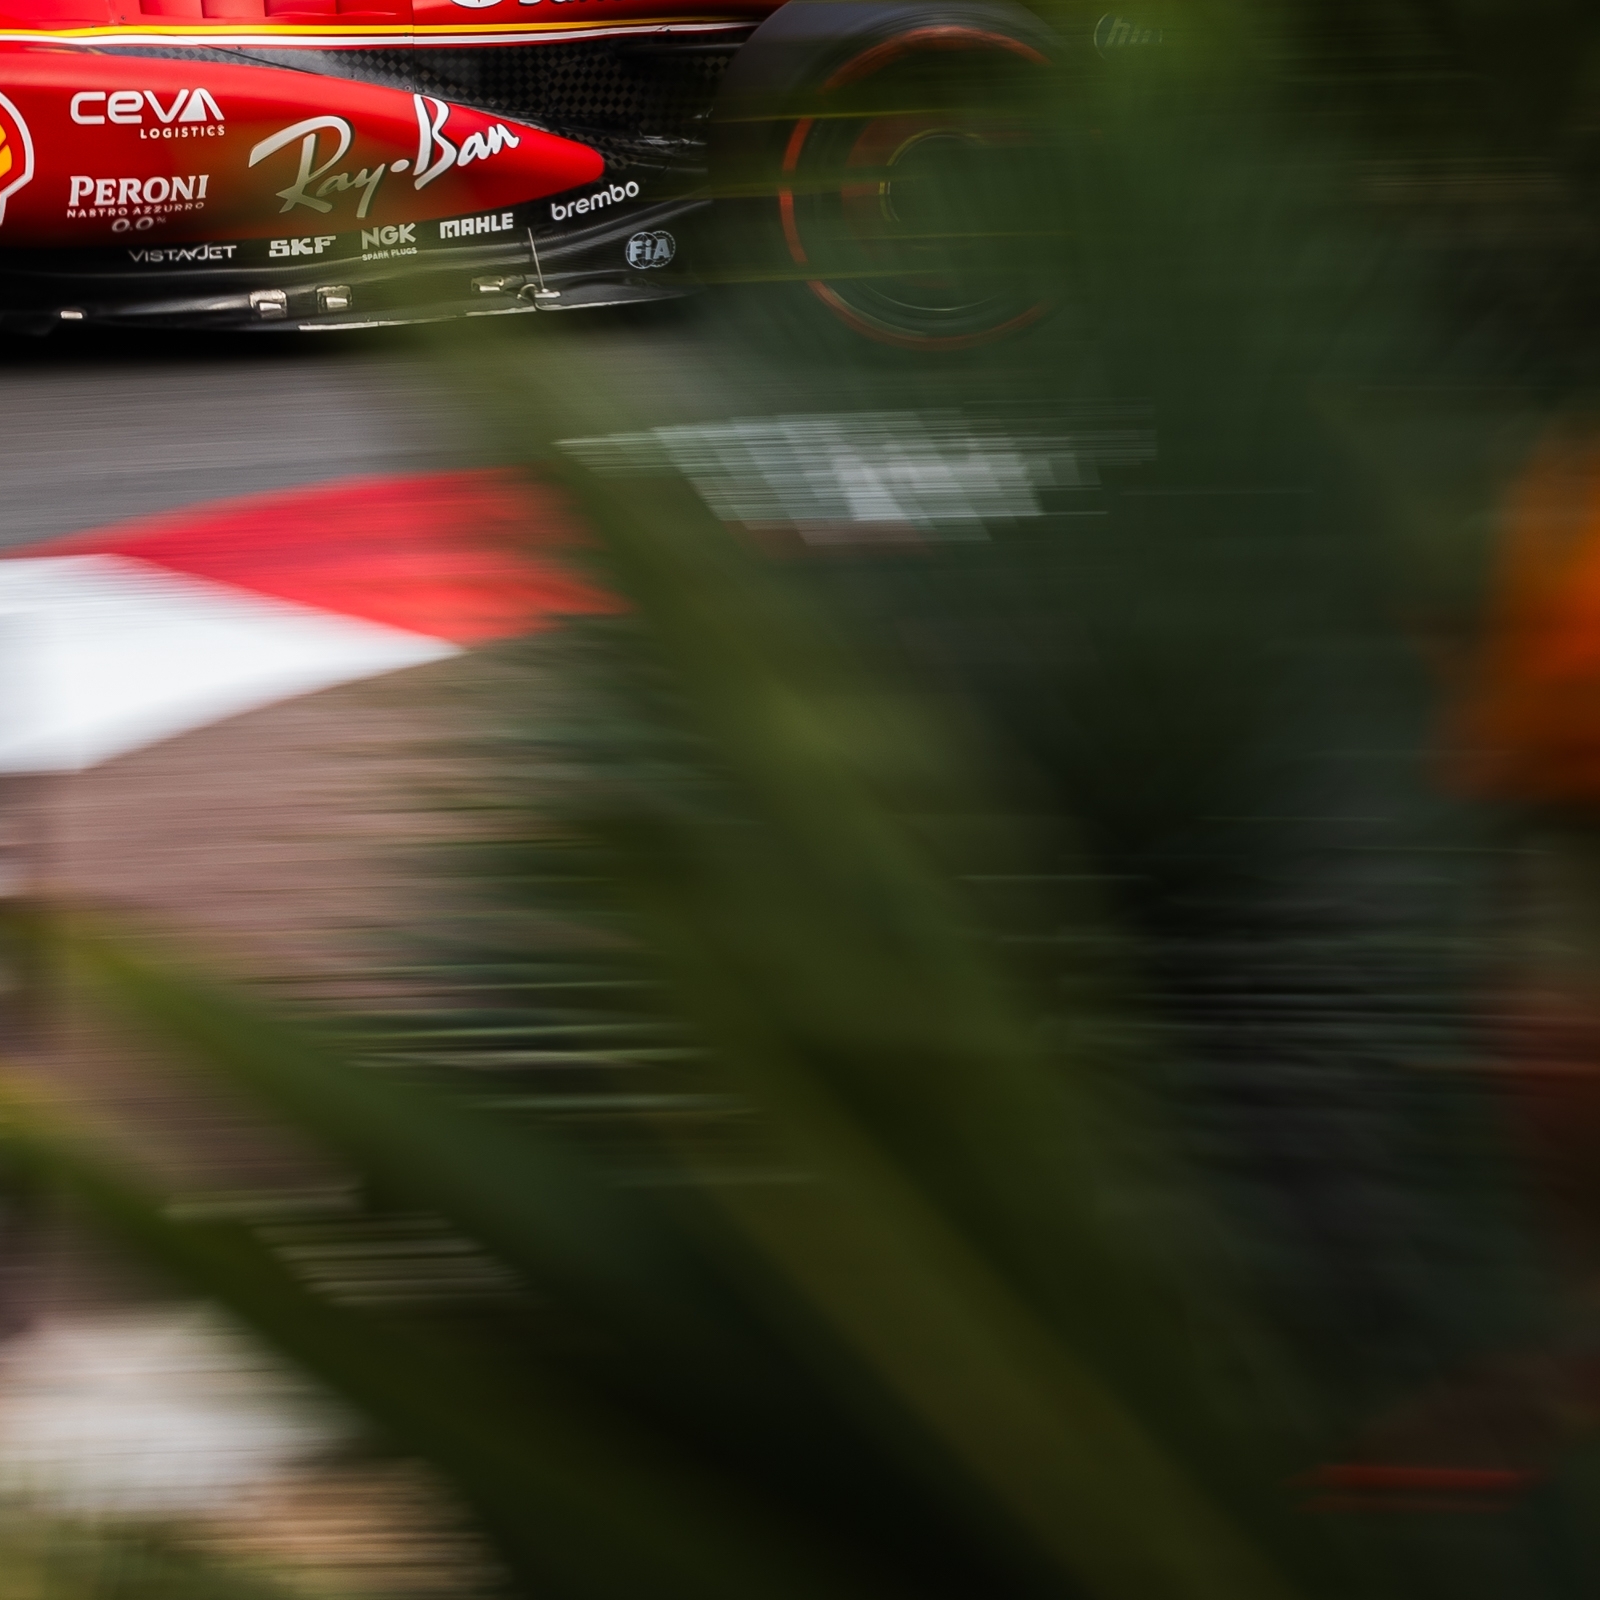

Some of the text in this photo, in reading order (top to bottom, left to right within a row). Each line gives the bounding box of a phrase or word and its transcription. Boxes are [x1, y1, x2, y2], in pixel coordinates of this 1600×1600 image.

[140, 125, 226, 140] LOGISTICS
[68, 174, 210, 208] PERONI
[551, 181, 640, 220] brembo
[67, 201, 205, 218] NASTRO AZZURRO
[360, 222, 417, 250] NGK
[439, 212, 514, 239] MAHLE
[269, 235, 337, 258] SKF
[362, 247, 418, 261] SPARK PLUGS
